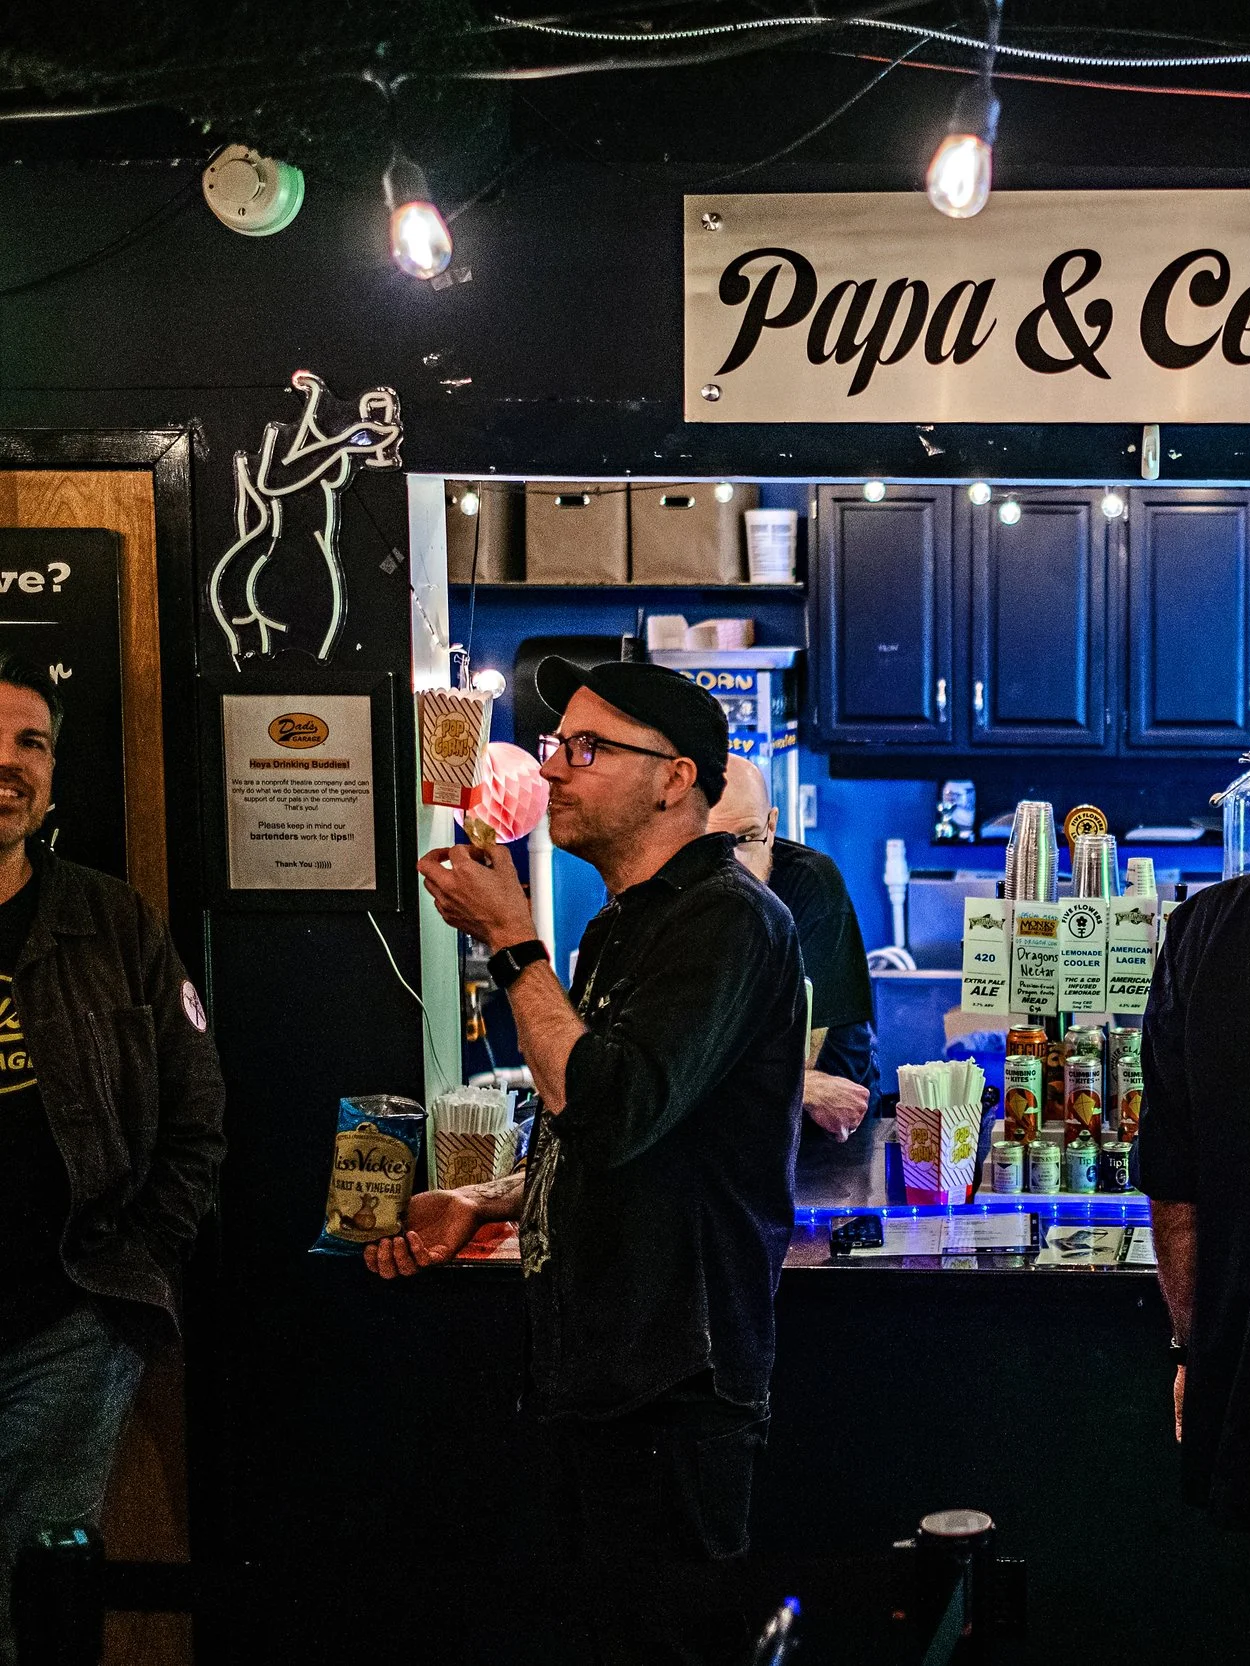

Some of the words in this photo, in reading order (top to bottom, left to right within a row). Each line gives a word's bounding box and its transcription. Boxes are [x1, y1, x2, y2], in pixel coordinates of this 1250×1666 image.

[713, 246, 997, 397] Papa
[1014, 247, 1114, 380] &
[278, 719, 318, 735] Dad's
[441, 719, 465, 739] POP
[434, 738, 469, 758] CORN!
[272, 760, 310, 770] Drinking
[311, 760, 350, 769] Buddies!
[231, 788, 245, 796] only
[246, 788, 255, 796] do
[255, 788, 272, 796] what
[272, 788, 282, 796] we
[283, 788, 291, 796] do
[292, 788, 320, 796] because
[320, 788, 328, 796] of
[328, 788, 339, 796] the
[340, 788, 370, 796] generous
[243, 796, 268, 804] support
[268, 796, 276, 804] of
[276, 796, 288, 804] our
[310, 796, 321, 804] the
[1071, 814, 1083, 827] FIVE
[258, 822, 286, 830] Please
[286, 822, 305, 830] keep
[306, 822, 313, 830] in
[314, 822, 332, 830] mind
[333, 822, 346, 830] our
[250, 833, 299, 842] bartenders
[299, 833, 318, 842] work
[319, 833, 329, 842] for
[330, 833, 355, 842] tips!!!
[1061, 908, 1075, 924] FIVE
[1073, 904, 1103, 925] FLOWERS
[1020, 920, 1055, 931] MONKS
[1110, 946, 1153, 954] AMERICAN
[974, 953, 996, 963] 420
[1016, 947, 1059, 968] Dragons
[1020, 964, 1055, 977] Nectar
[963, 977, 987, 985] EXTRA
[1110, 976, 1152, 984] AMERICAN
[970, 986, 1000, 997] ALE
[1021, 996, 1048, 1005] MEAD
[1005, 1068, 1037, 1078] CLIMBING
[1068, 1070, 1101, 1078] CLIMBING
[1122, 1070, 1143, 1078] CLIM
[353, 1147, 412, 1180] Vickie's
[335, 1180, 354, 1191] SALT
[356, 1182, 364, 1192] &
[366, 1182, 402, 1195] VINEGAR
